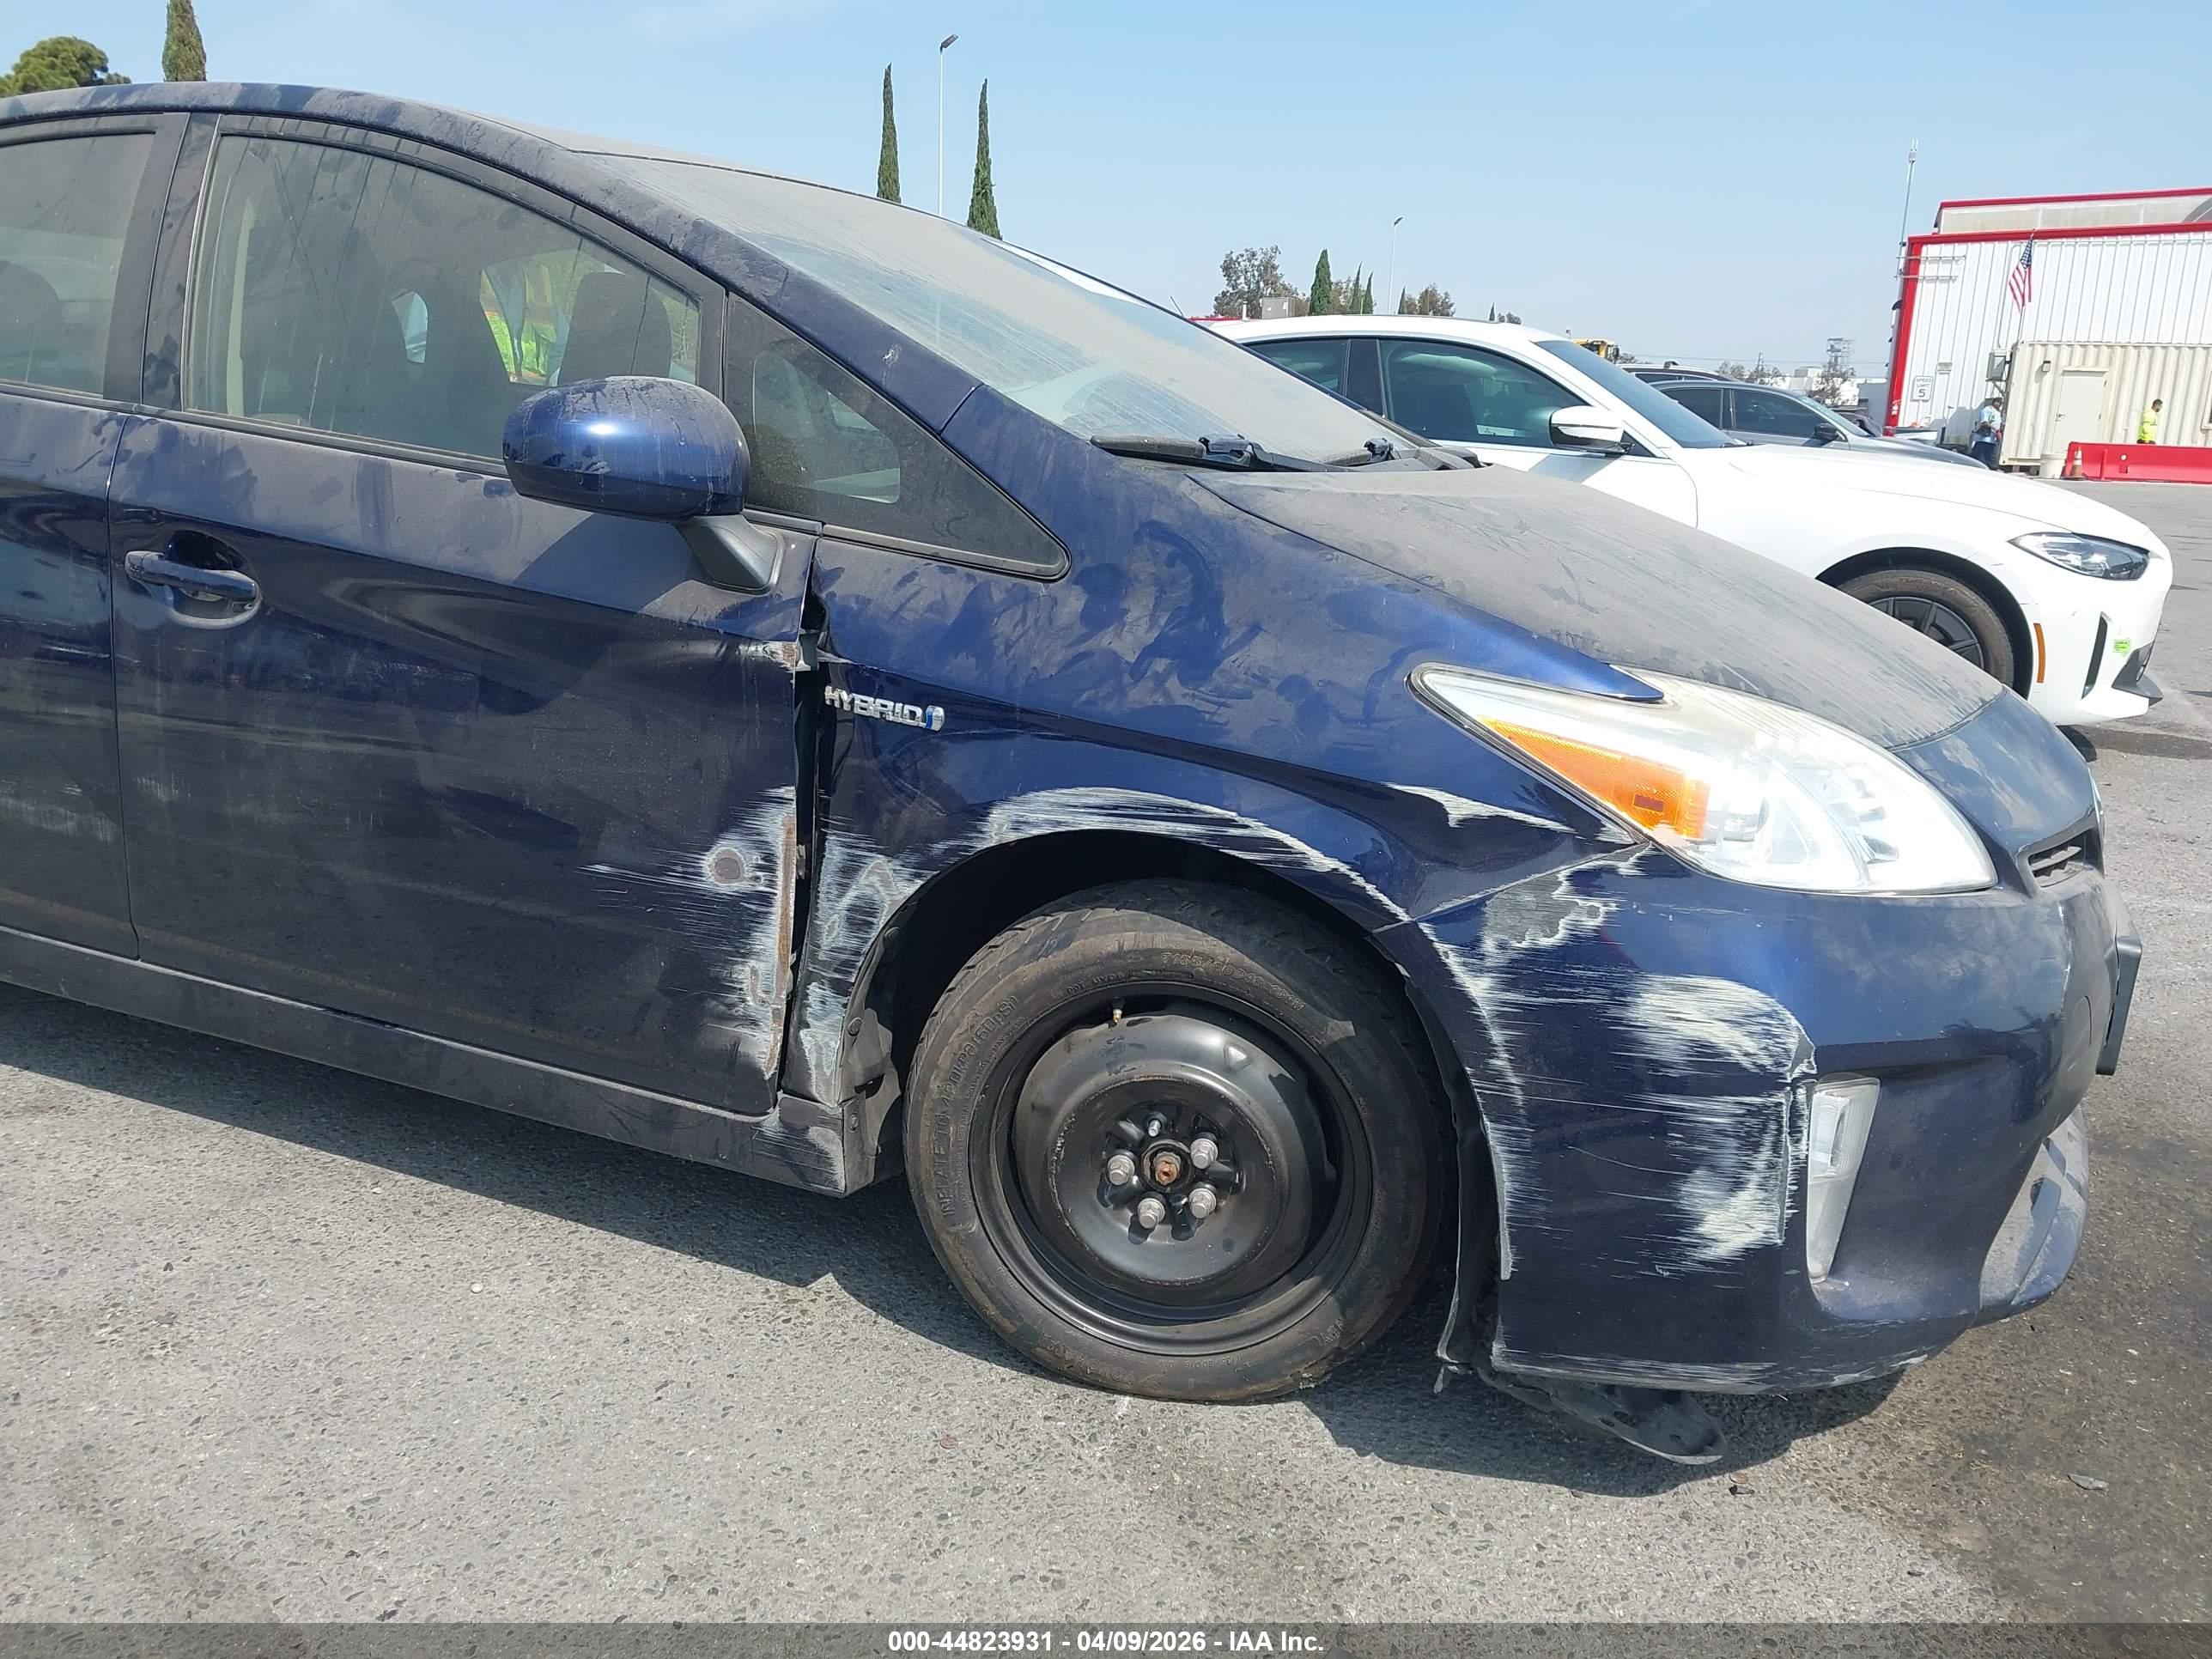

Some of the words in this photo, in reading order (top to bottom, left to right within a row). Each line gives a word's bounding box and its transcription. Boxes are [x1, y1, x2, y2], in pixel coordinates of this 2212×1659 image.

[1917, 389, 1926, 398] 5
[824, 685, 925, 727] HYBRID
[934, 1143, 956, 1217] INFLATE
